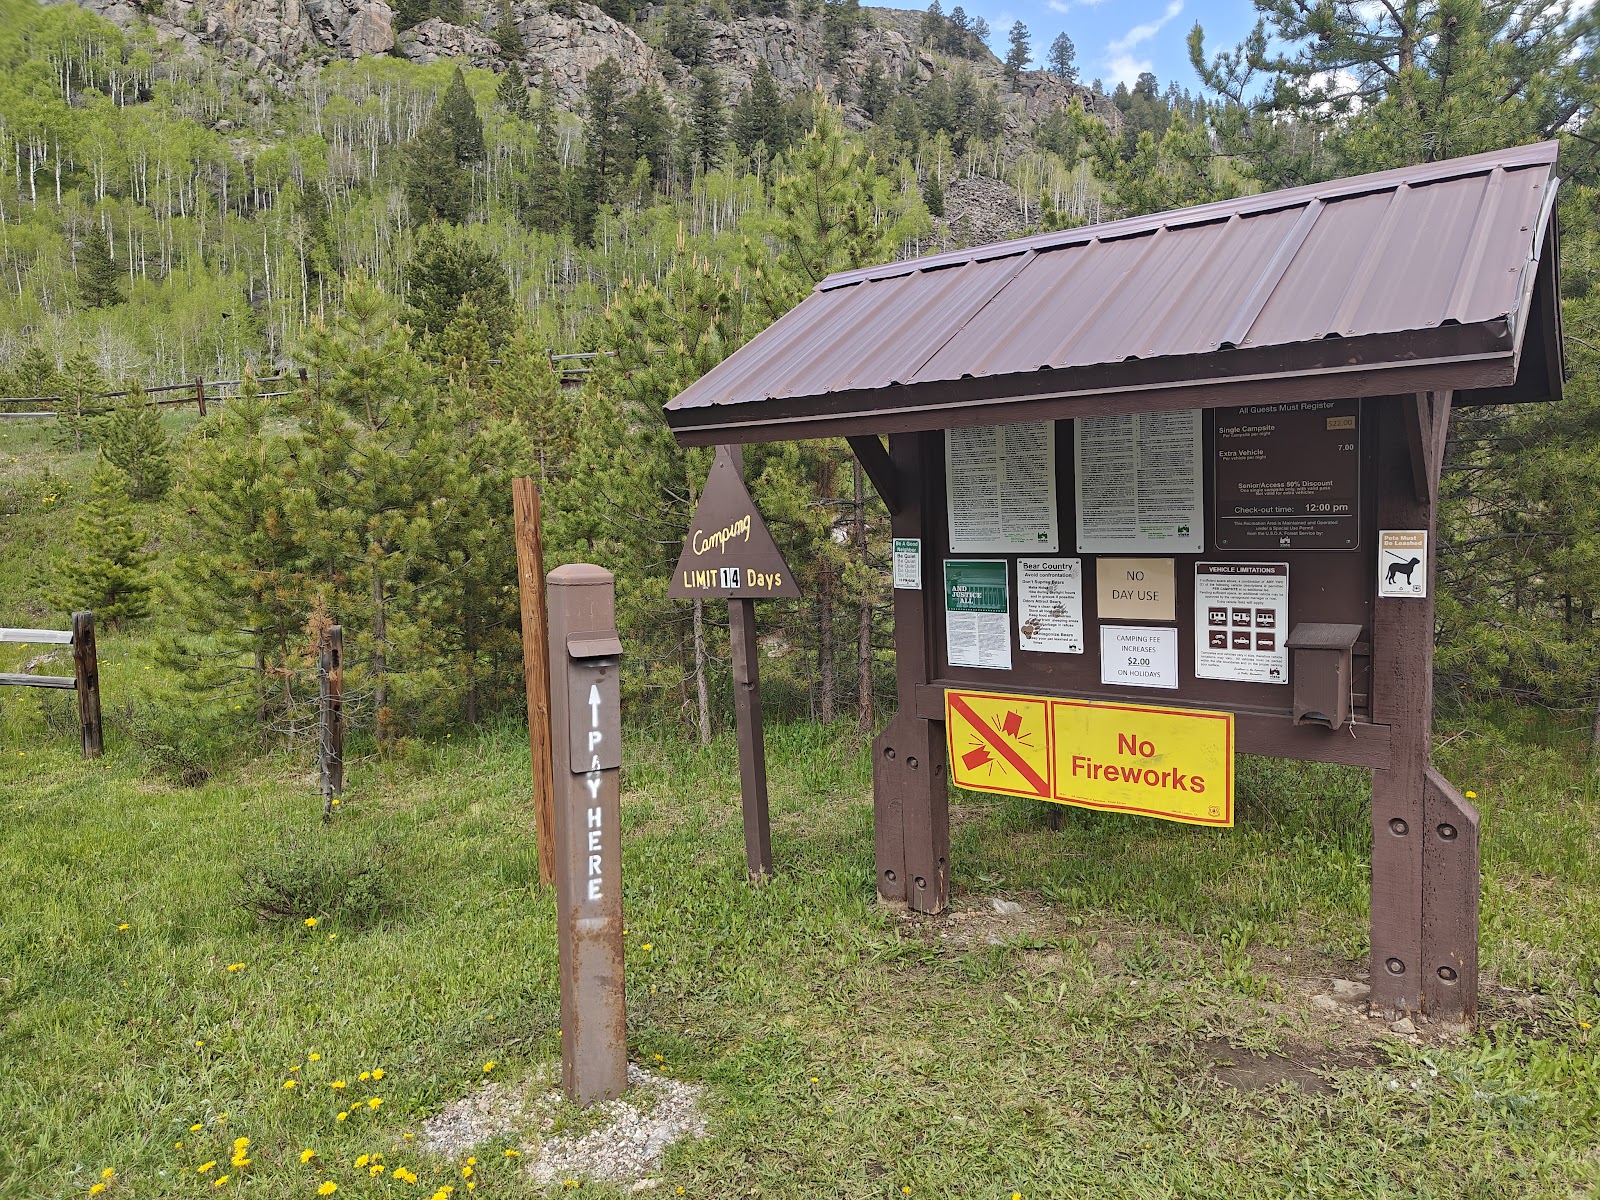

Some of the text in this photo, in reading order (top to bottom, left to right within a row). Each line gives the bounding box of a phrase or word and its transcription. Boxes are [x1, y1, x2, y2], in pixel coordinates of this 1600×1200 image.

[1250, 405, 1277, 414] Guests
[1301, 401, 1335, 411] Register
[1242, 425, 1275, 433] Campsite
[1328, 419, 1352, 428] $22.00
[1234, 506, 1273, 514] Check-out
[1305, 503, 1330, 512] 12:00
[1333, 504, 1348, 513] pm
[692, 514, 750, 555] Camping
[683, 568, 782, 590] LIMIT 14 Days
[1127, 571, 1144, 581] NO
[1112, 590, 1159, 601] DAY USE
[1128, 657, 1150, 666] $2.00
[1118, 732, 1156, 758] No
[1072, 755, 1205, 794] Fireworks
[587, 730, 603, 900] PAY HERE
